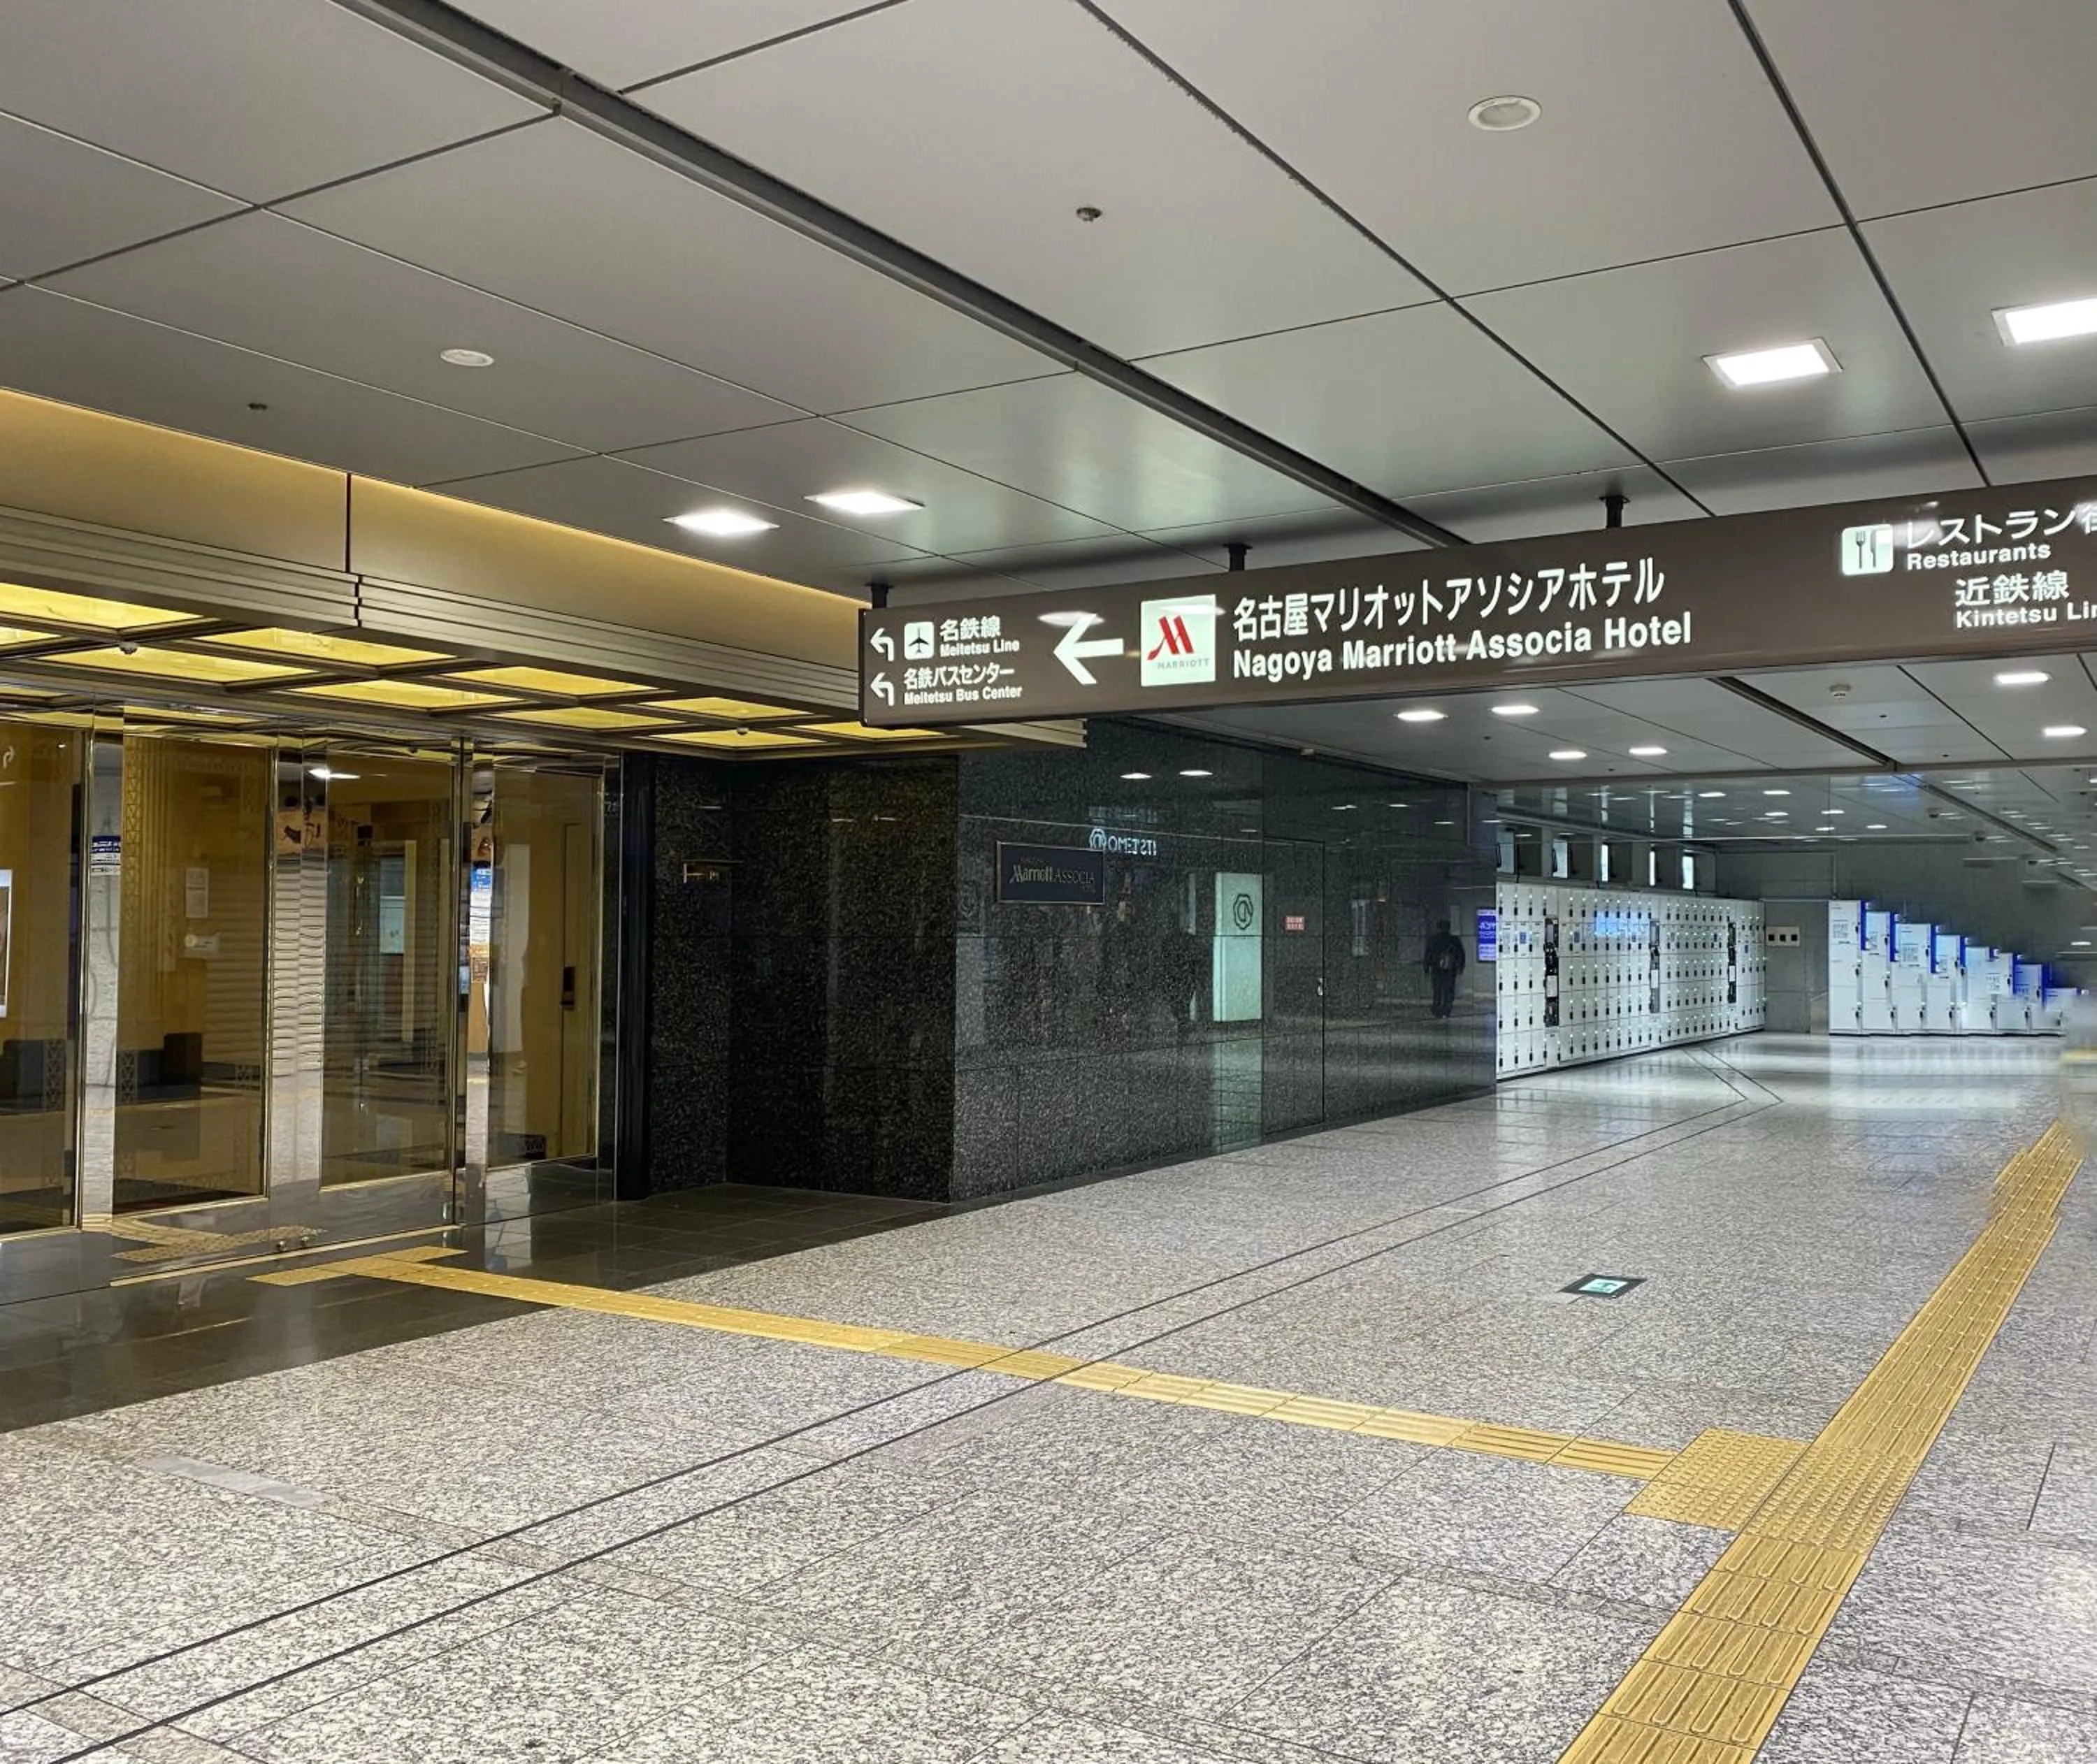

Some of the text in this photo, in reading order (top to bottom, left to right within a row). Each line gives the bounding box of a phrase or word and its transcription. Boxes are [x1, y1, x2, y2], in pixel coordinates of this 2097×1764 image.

[1907, 542, 2051, 570] Restaurants
[1233, 557, 1664, 642] 名古屋マリオットアソシアホテル
[1955, 570, 2070, 607] 近鉄線
[939, 615, 1001, 642] 名鉄線
[1957, 607, 2057, 628] Kintetsu
[940, 639, 1020, 657] Meitetsu Line
[1234, 611, 1691, 683] Nagoya Marriott Associa Hotel
[904, 662, 1015, 690] 名鉄バスセンター
[1157, 658, 1210, 670] MARRIOTT
[904, 686, 1023, 705] Meitetsu Bus Center
